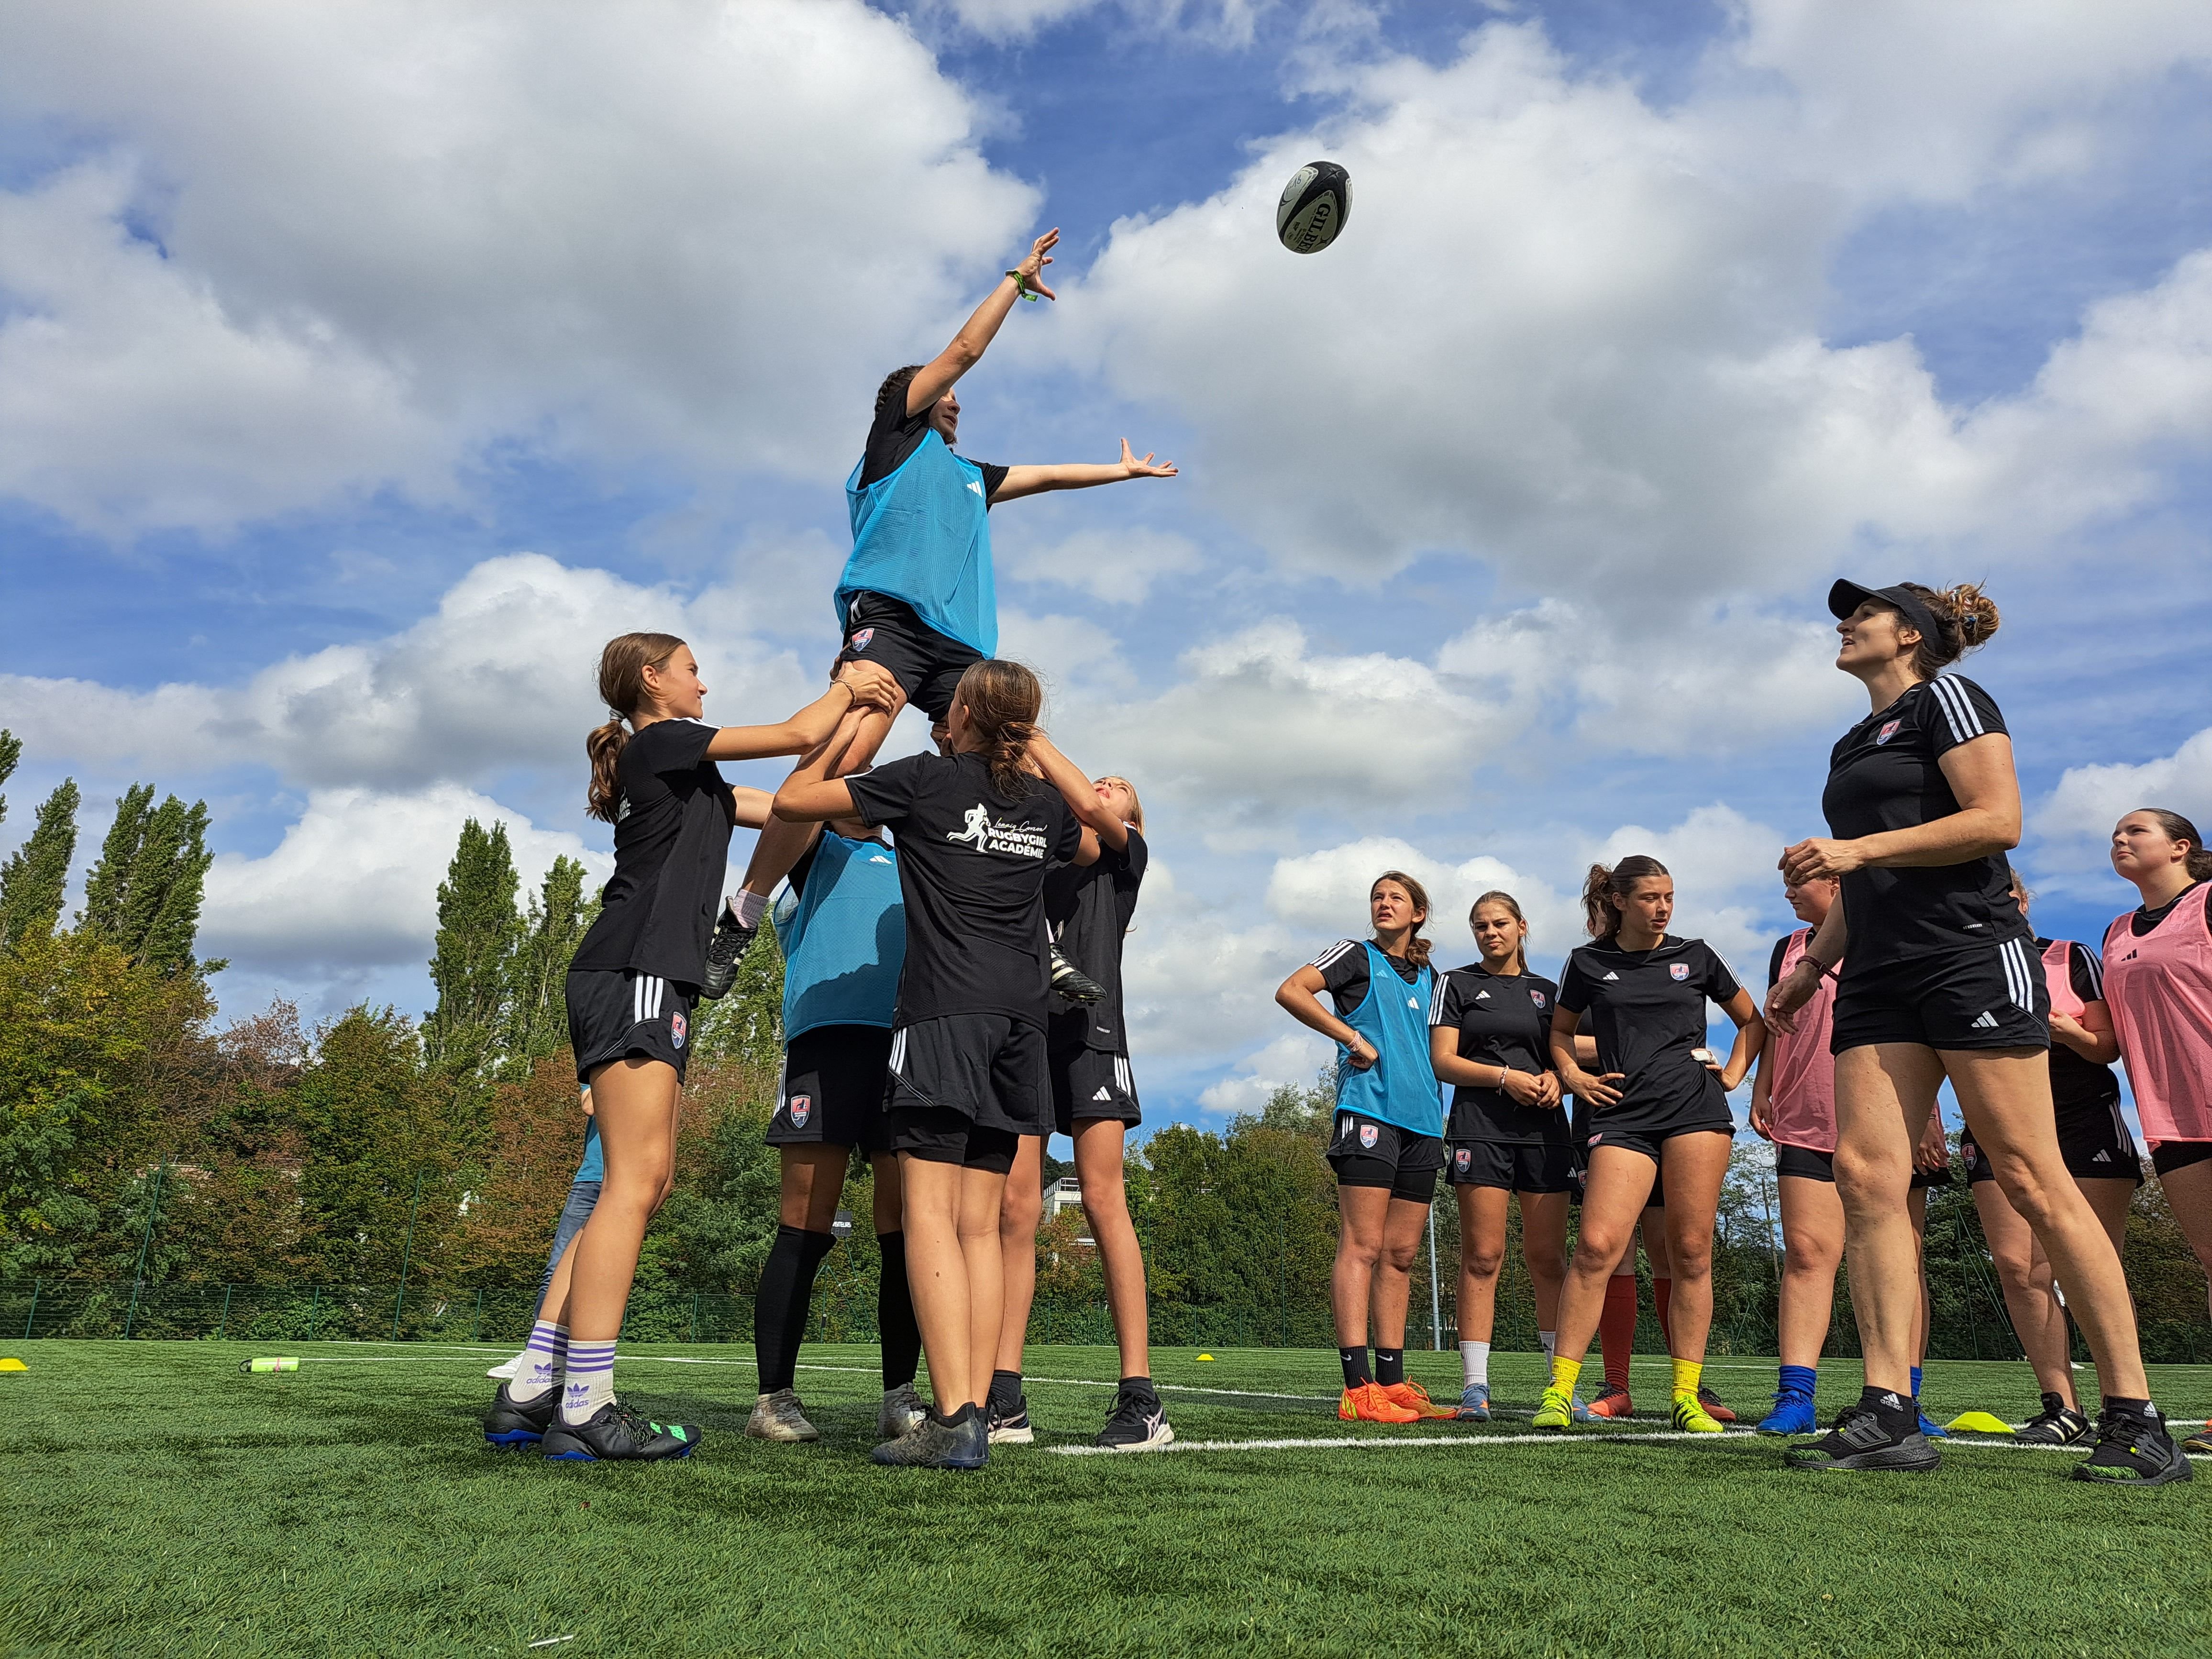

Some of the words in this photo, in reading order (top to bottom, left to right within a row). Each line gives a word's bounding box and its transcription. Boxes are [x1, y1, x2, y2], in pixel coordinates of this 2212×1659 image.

[1293, 203, 1330, 253] GILBER
[988, 827, 1047, 848] RUGBYGIRL
[988, 839, 1044, 859] ACADÉMIE
[565, 1399, 590, 1409] adidas
[1880, 1399, 1903, 1411] adidas
